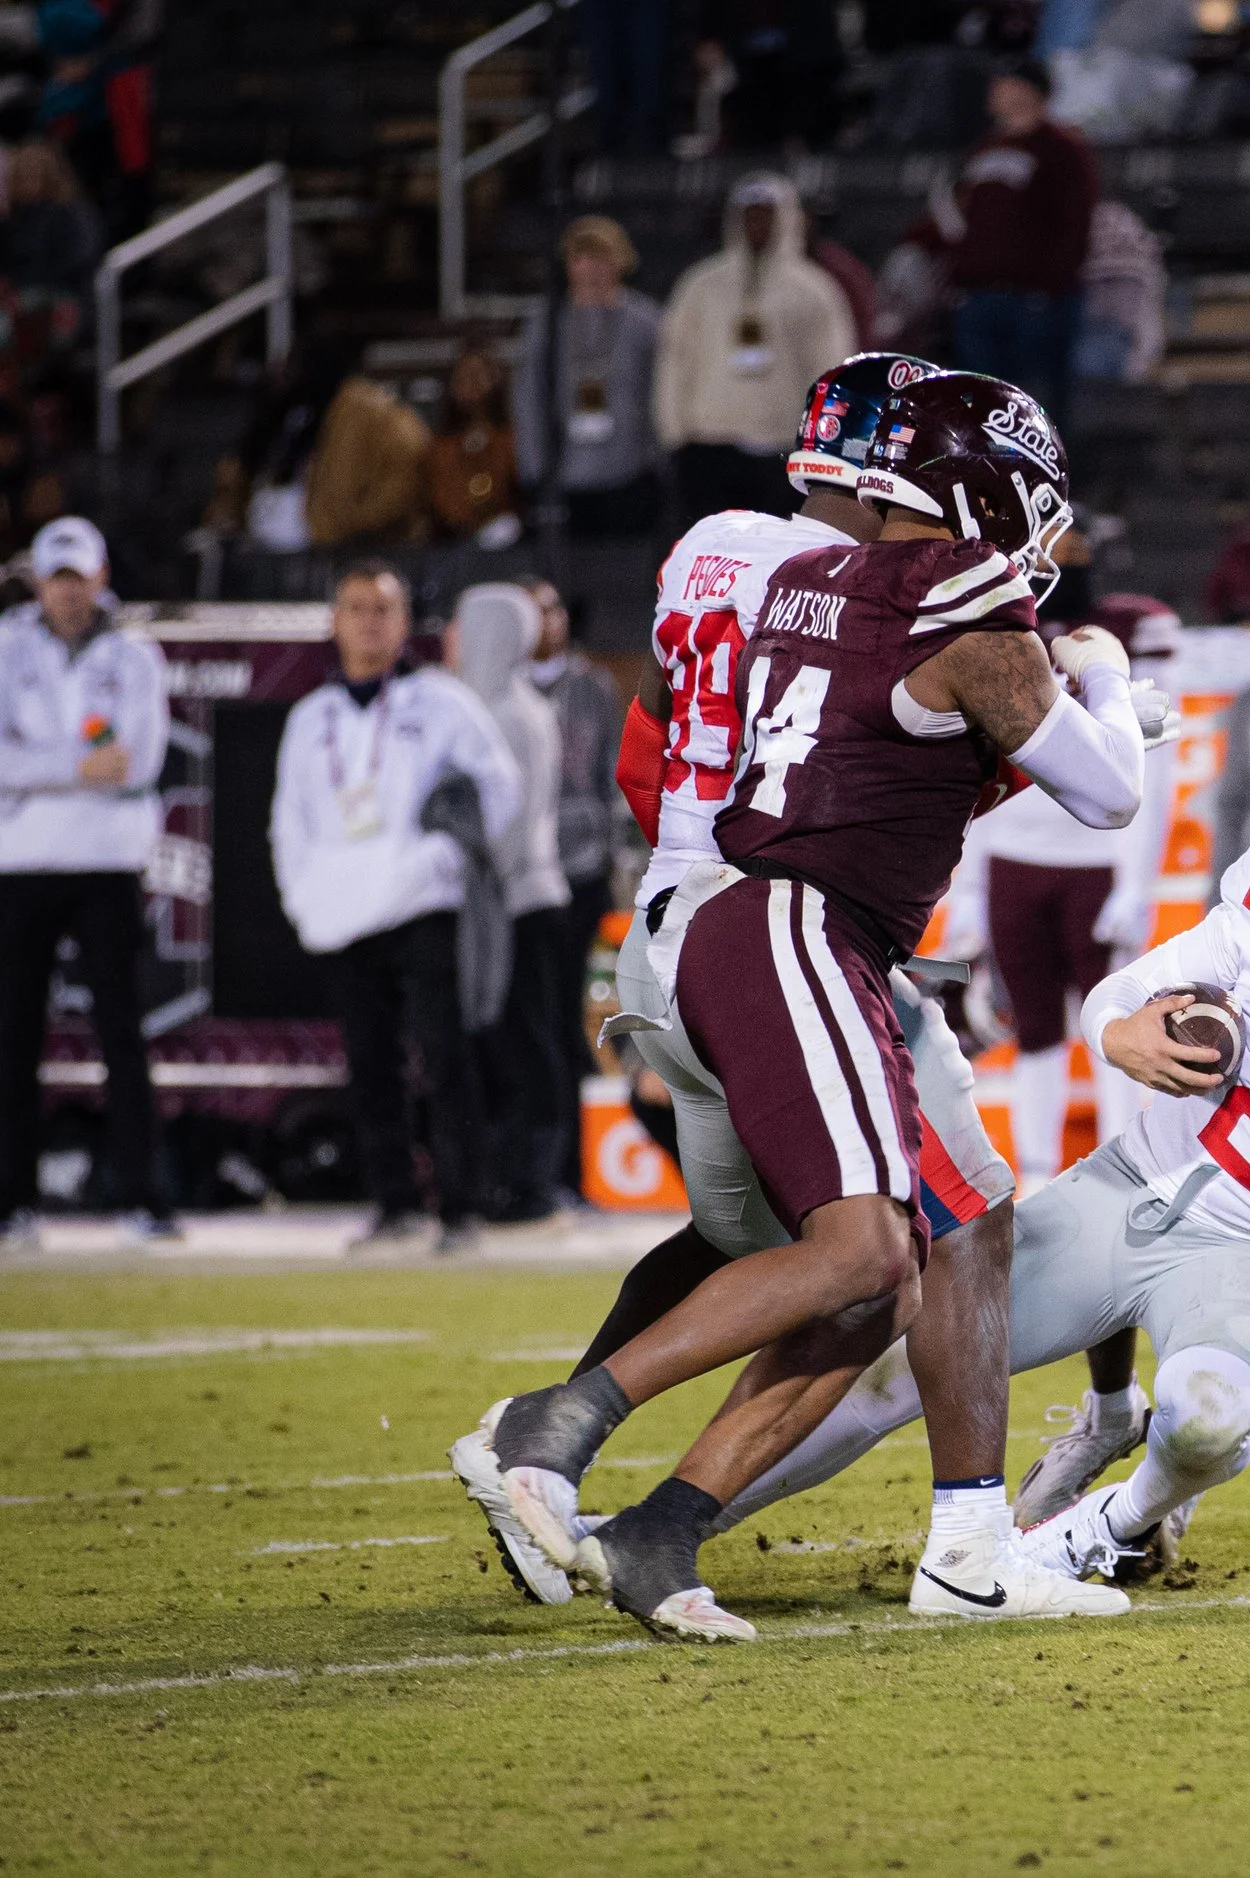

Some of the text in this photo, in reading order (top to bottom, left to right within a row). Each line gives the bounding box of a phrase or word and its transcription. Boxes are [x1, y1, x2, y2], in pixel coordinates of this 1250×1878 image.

[981, 401, 1060, 480] State
[803, 462, 844, 476] TODDY
[683, 555, 752, 600] PEGUES
[764, 587, 847, 640] WATSON
[743, 656, 832, 818] 14
